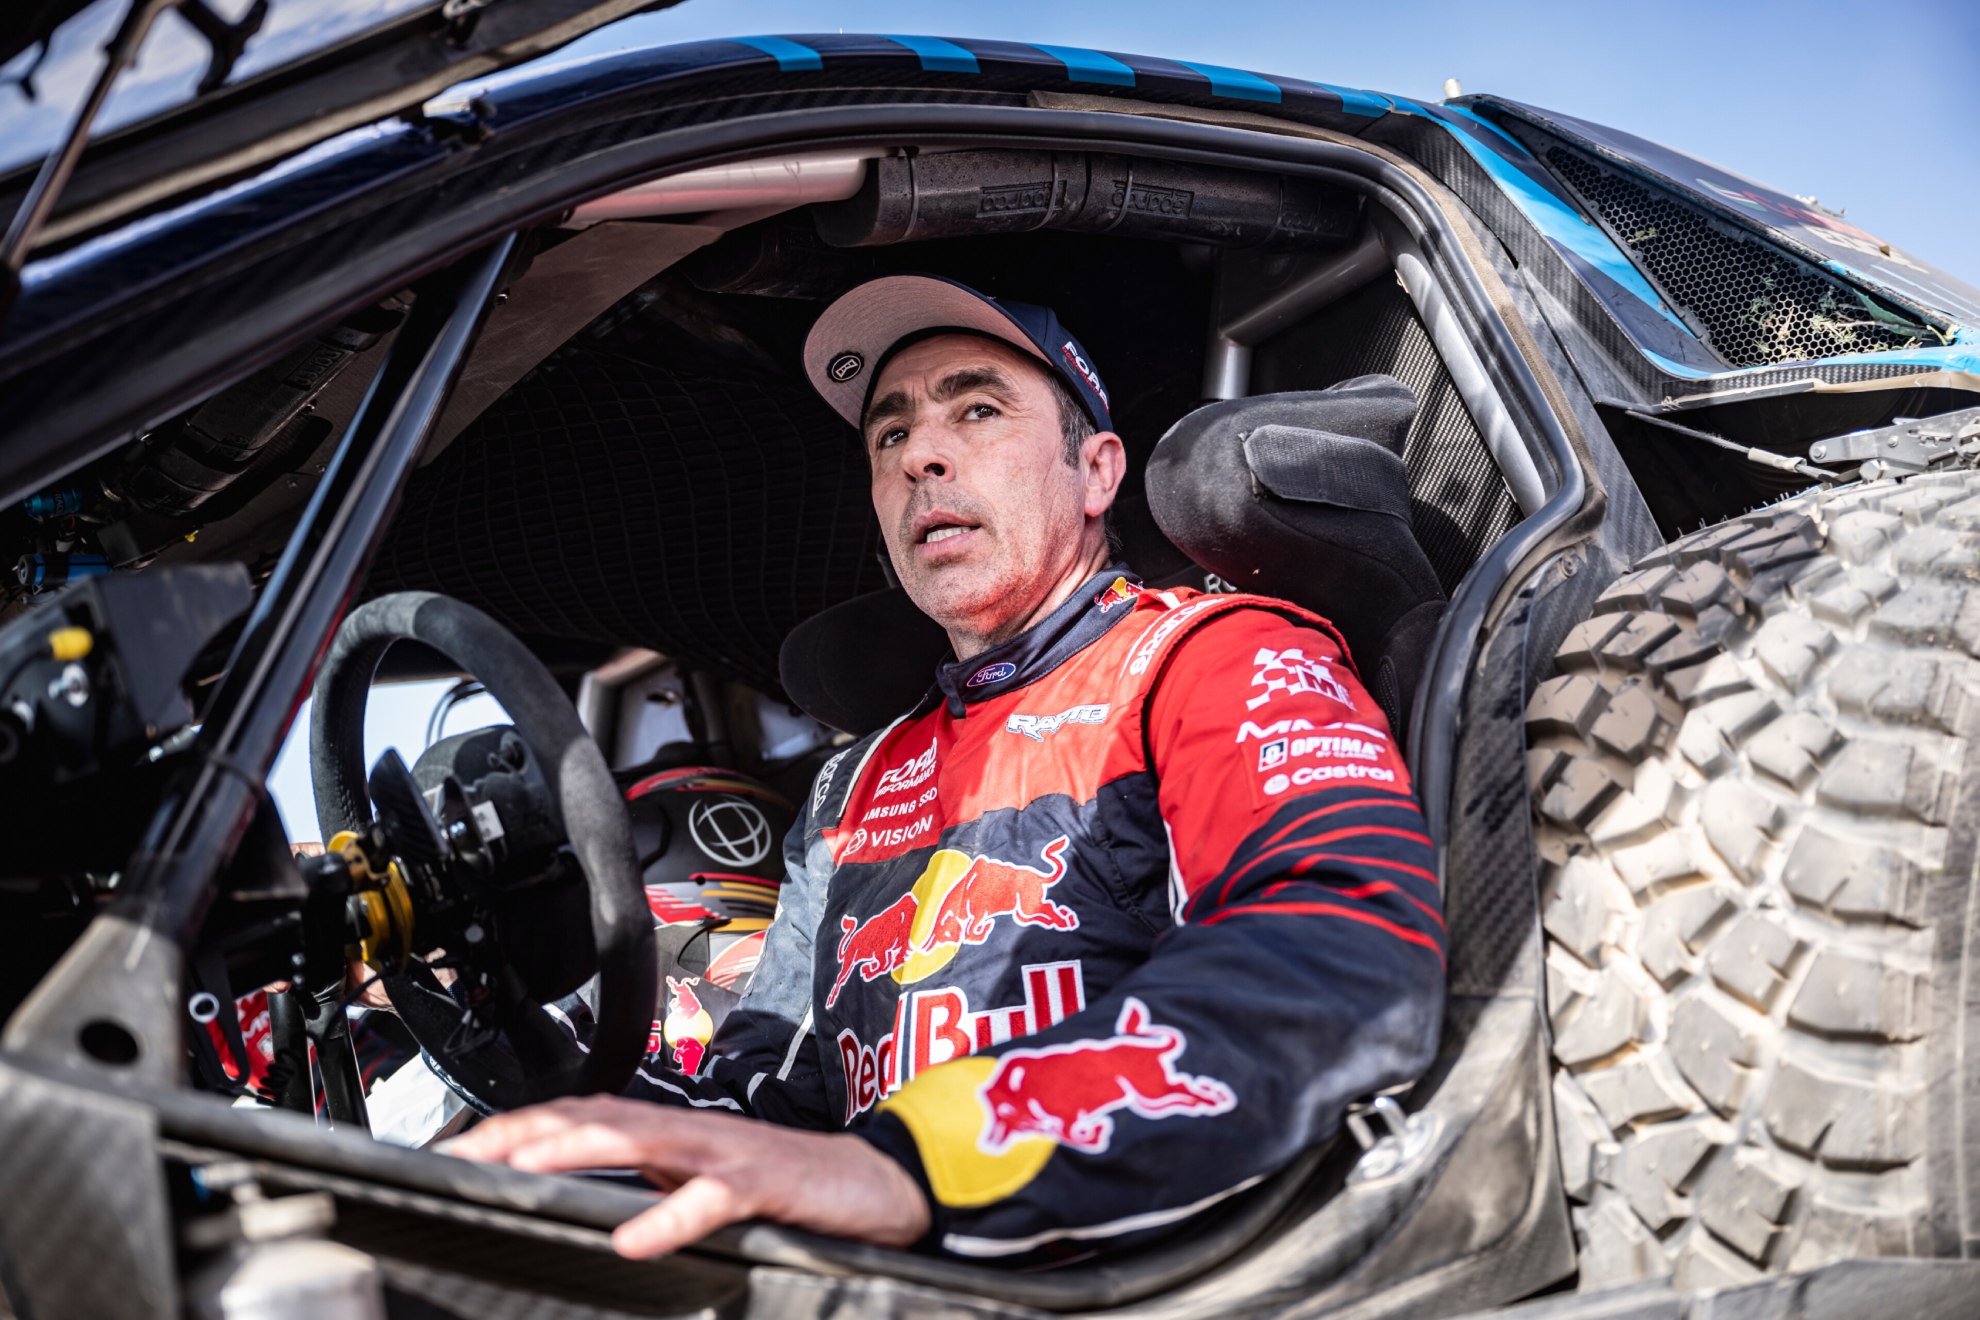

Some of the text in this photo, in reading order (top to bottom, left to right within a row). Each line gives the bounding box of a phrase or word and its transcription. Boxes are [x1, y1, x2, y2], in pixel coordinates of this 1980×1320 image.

[976, 666, 1007, 683] Ford
[876, 737, 938, 789] FORD
[1290, 736, 1377, 757] OPTIMA
[1291, 763, 1395, 785] Castrol
[861, 786, 938, 823] AMSUNG SSD
[871, 814, 933, 848] VISION
[837, 991, 904, 1127] Red
